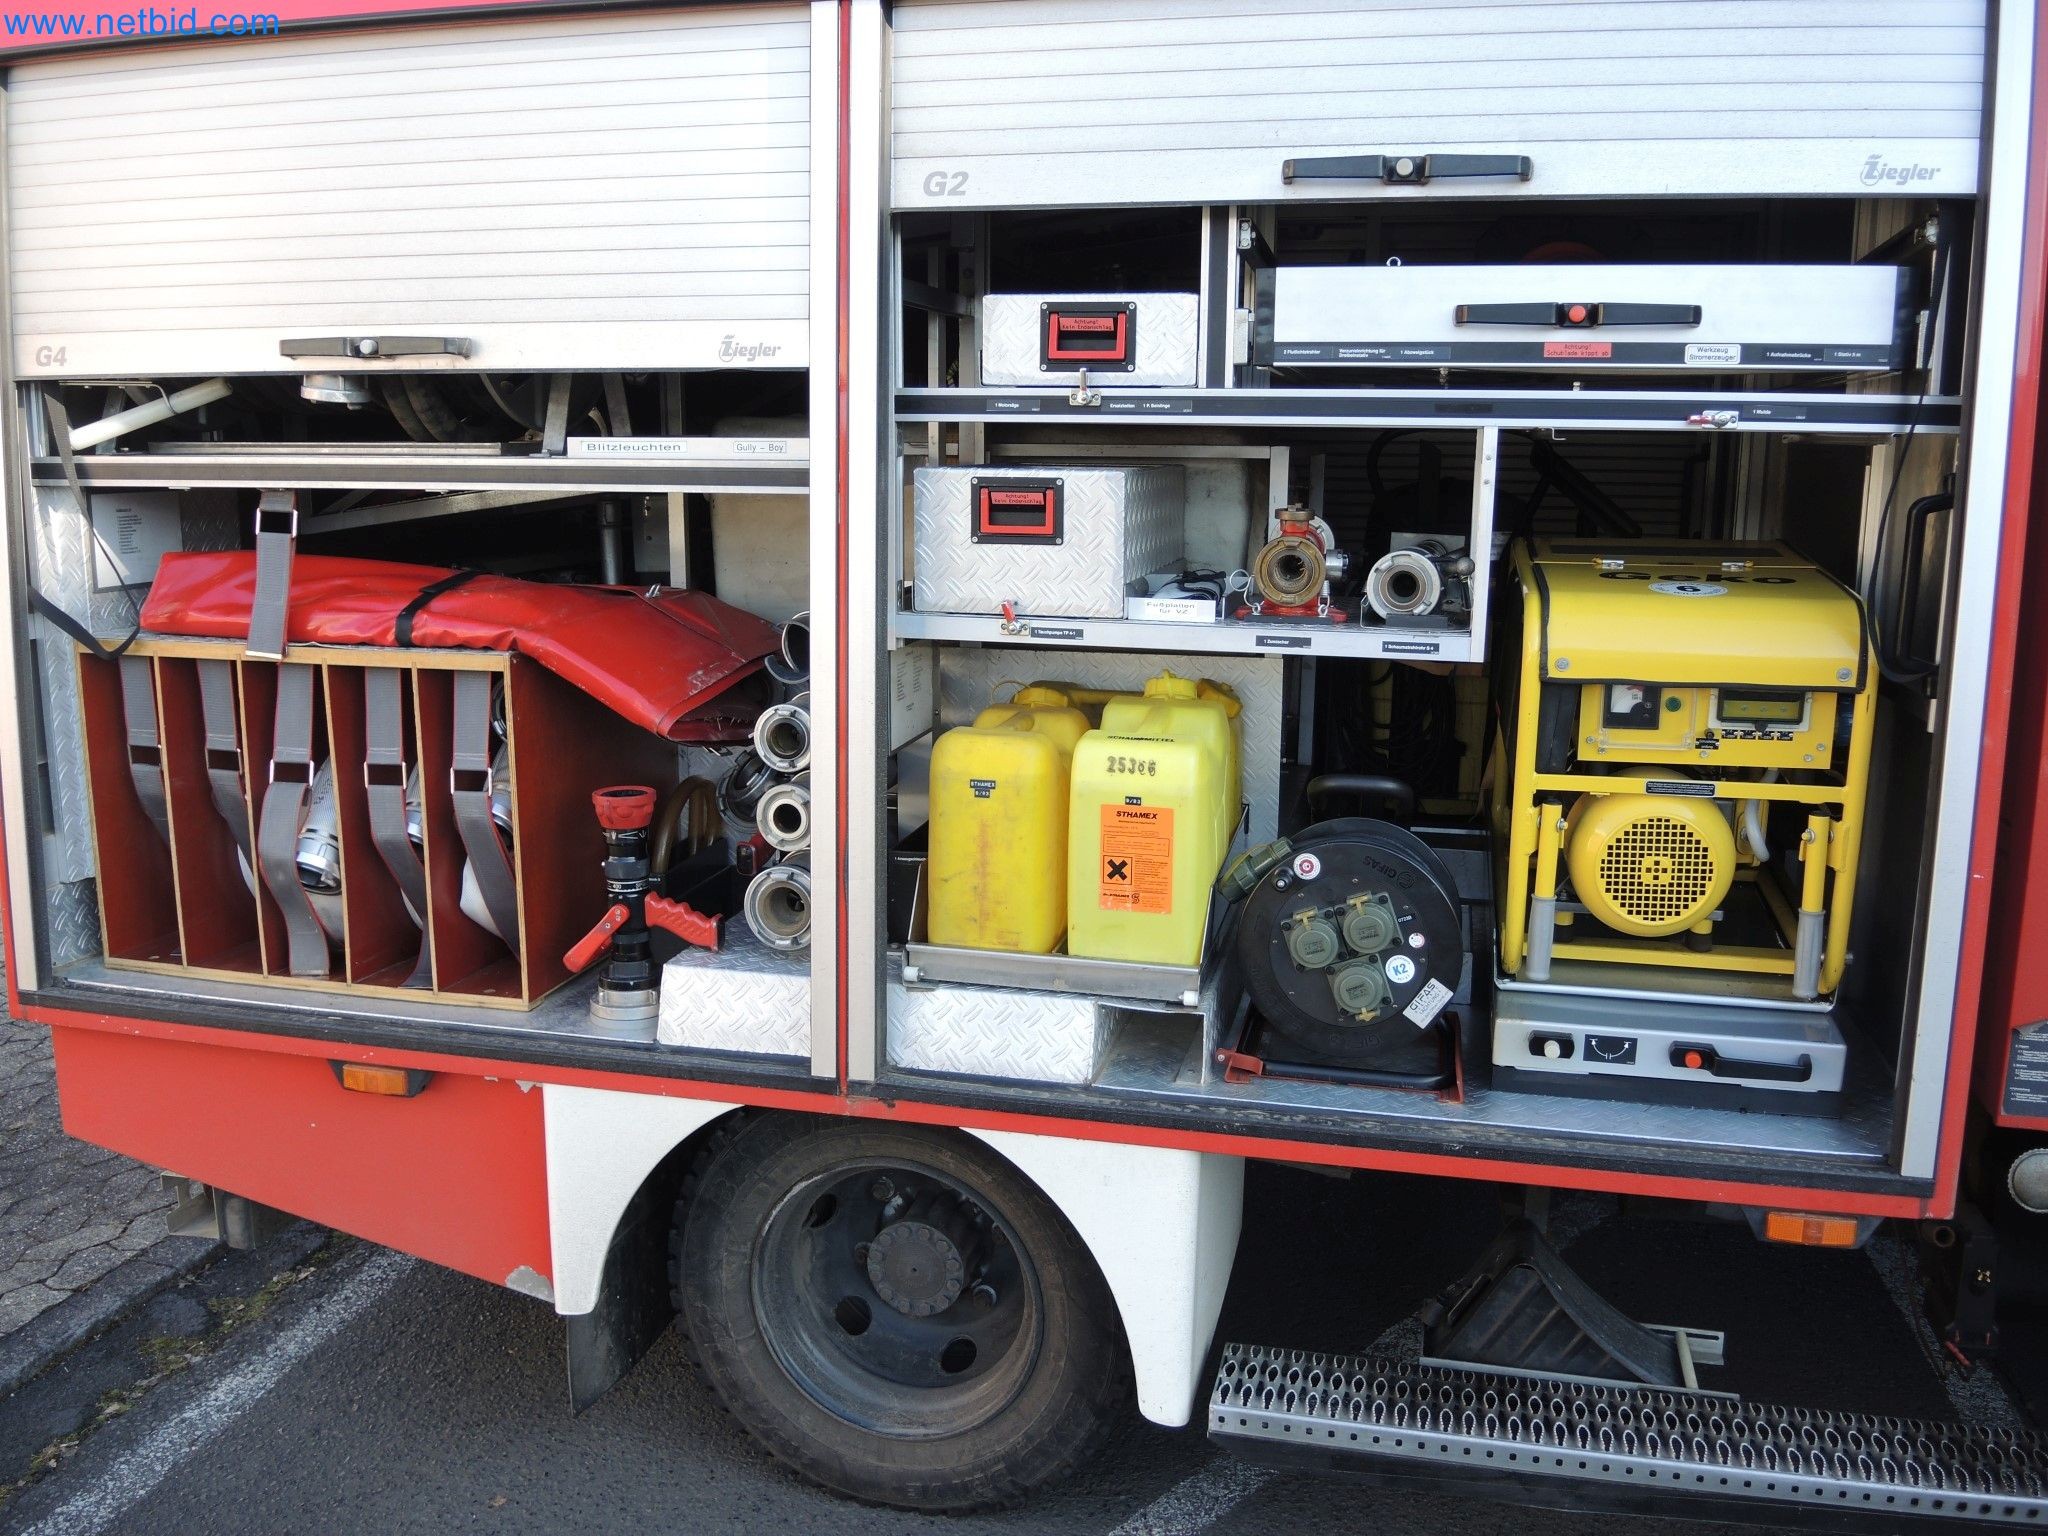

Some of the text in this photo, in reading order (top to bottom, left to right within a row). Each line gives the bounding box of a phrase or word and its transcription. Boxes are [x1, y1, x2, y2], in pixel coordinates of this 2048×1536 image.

[1860, 154, 1942, 187] Ziegler
[923, 171, 970, 197] G2
[718, 334, 782, 363] Ziegler
[1697, 346, 1729, 354] Werkzeug
[35, 345, 68, 368] G4
[586, 443, 682, 452] Blitzleuchten
[736, 443, 756, 454] Gully
[768, 443, 784, 453] Boy
[1146, 601, 1196, 609] Fußplatten
[1116, 810, 1158, 820] STHAMEX
[1392, 963, 1409, 977] K2
[1409, 981, 1438, 1011] GIFAS
